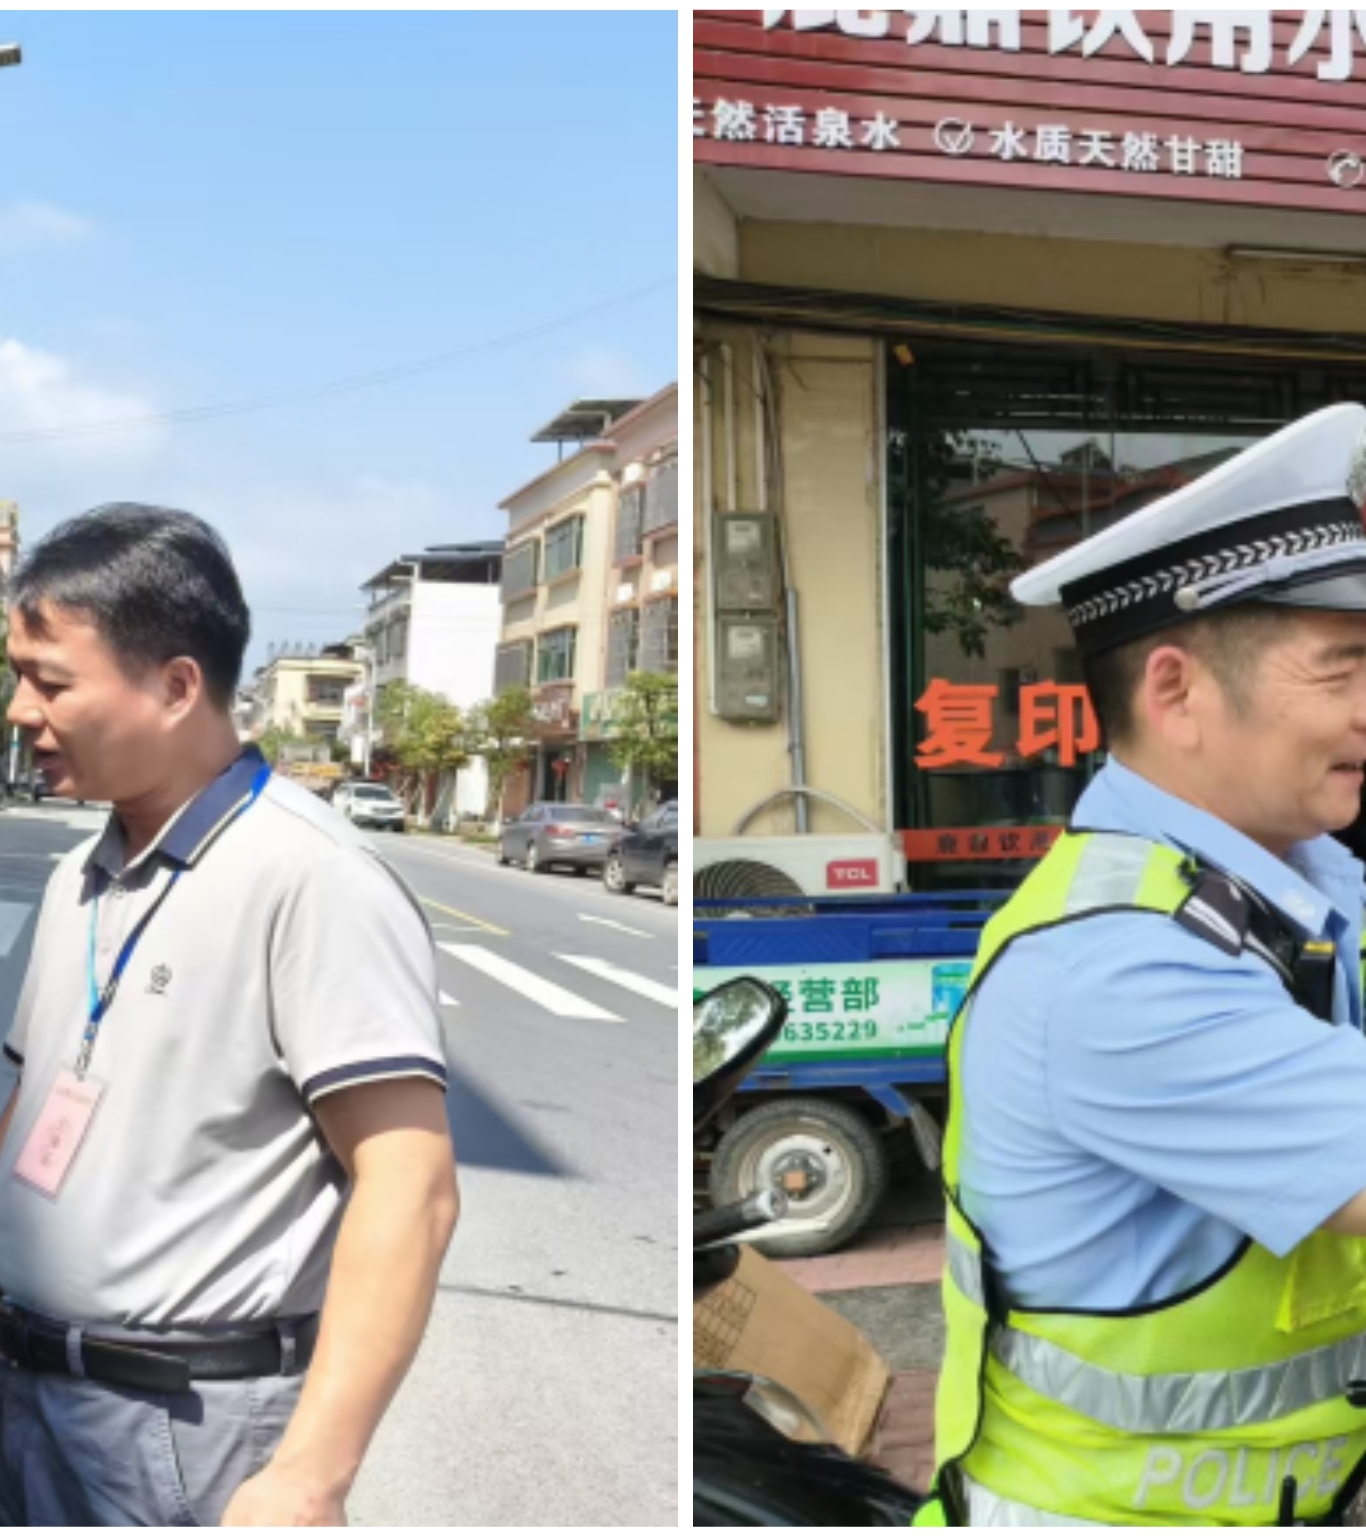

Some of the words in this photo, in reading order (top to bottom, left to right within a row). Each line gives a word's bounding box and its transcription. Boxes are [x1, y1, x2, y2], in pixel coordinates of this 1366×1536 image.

[988, 120, 1245, 179] 水质天然甘甜
[914, 678, 1101, 768] 复印
[833, 867, 873, 880] TCL
[1132, 1436, 1348, 1510] POLICE
